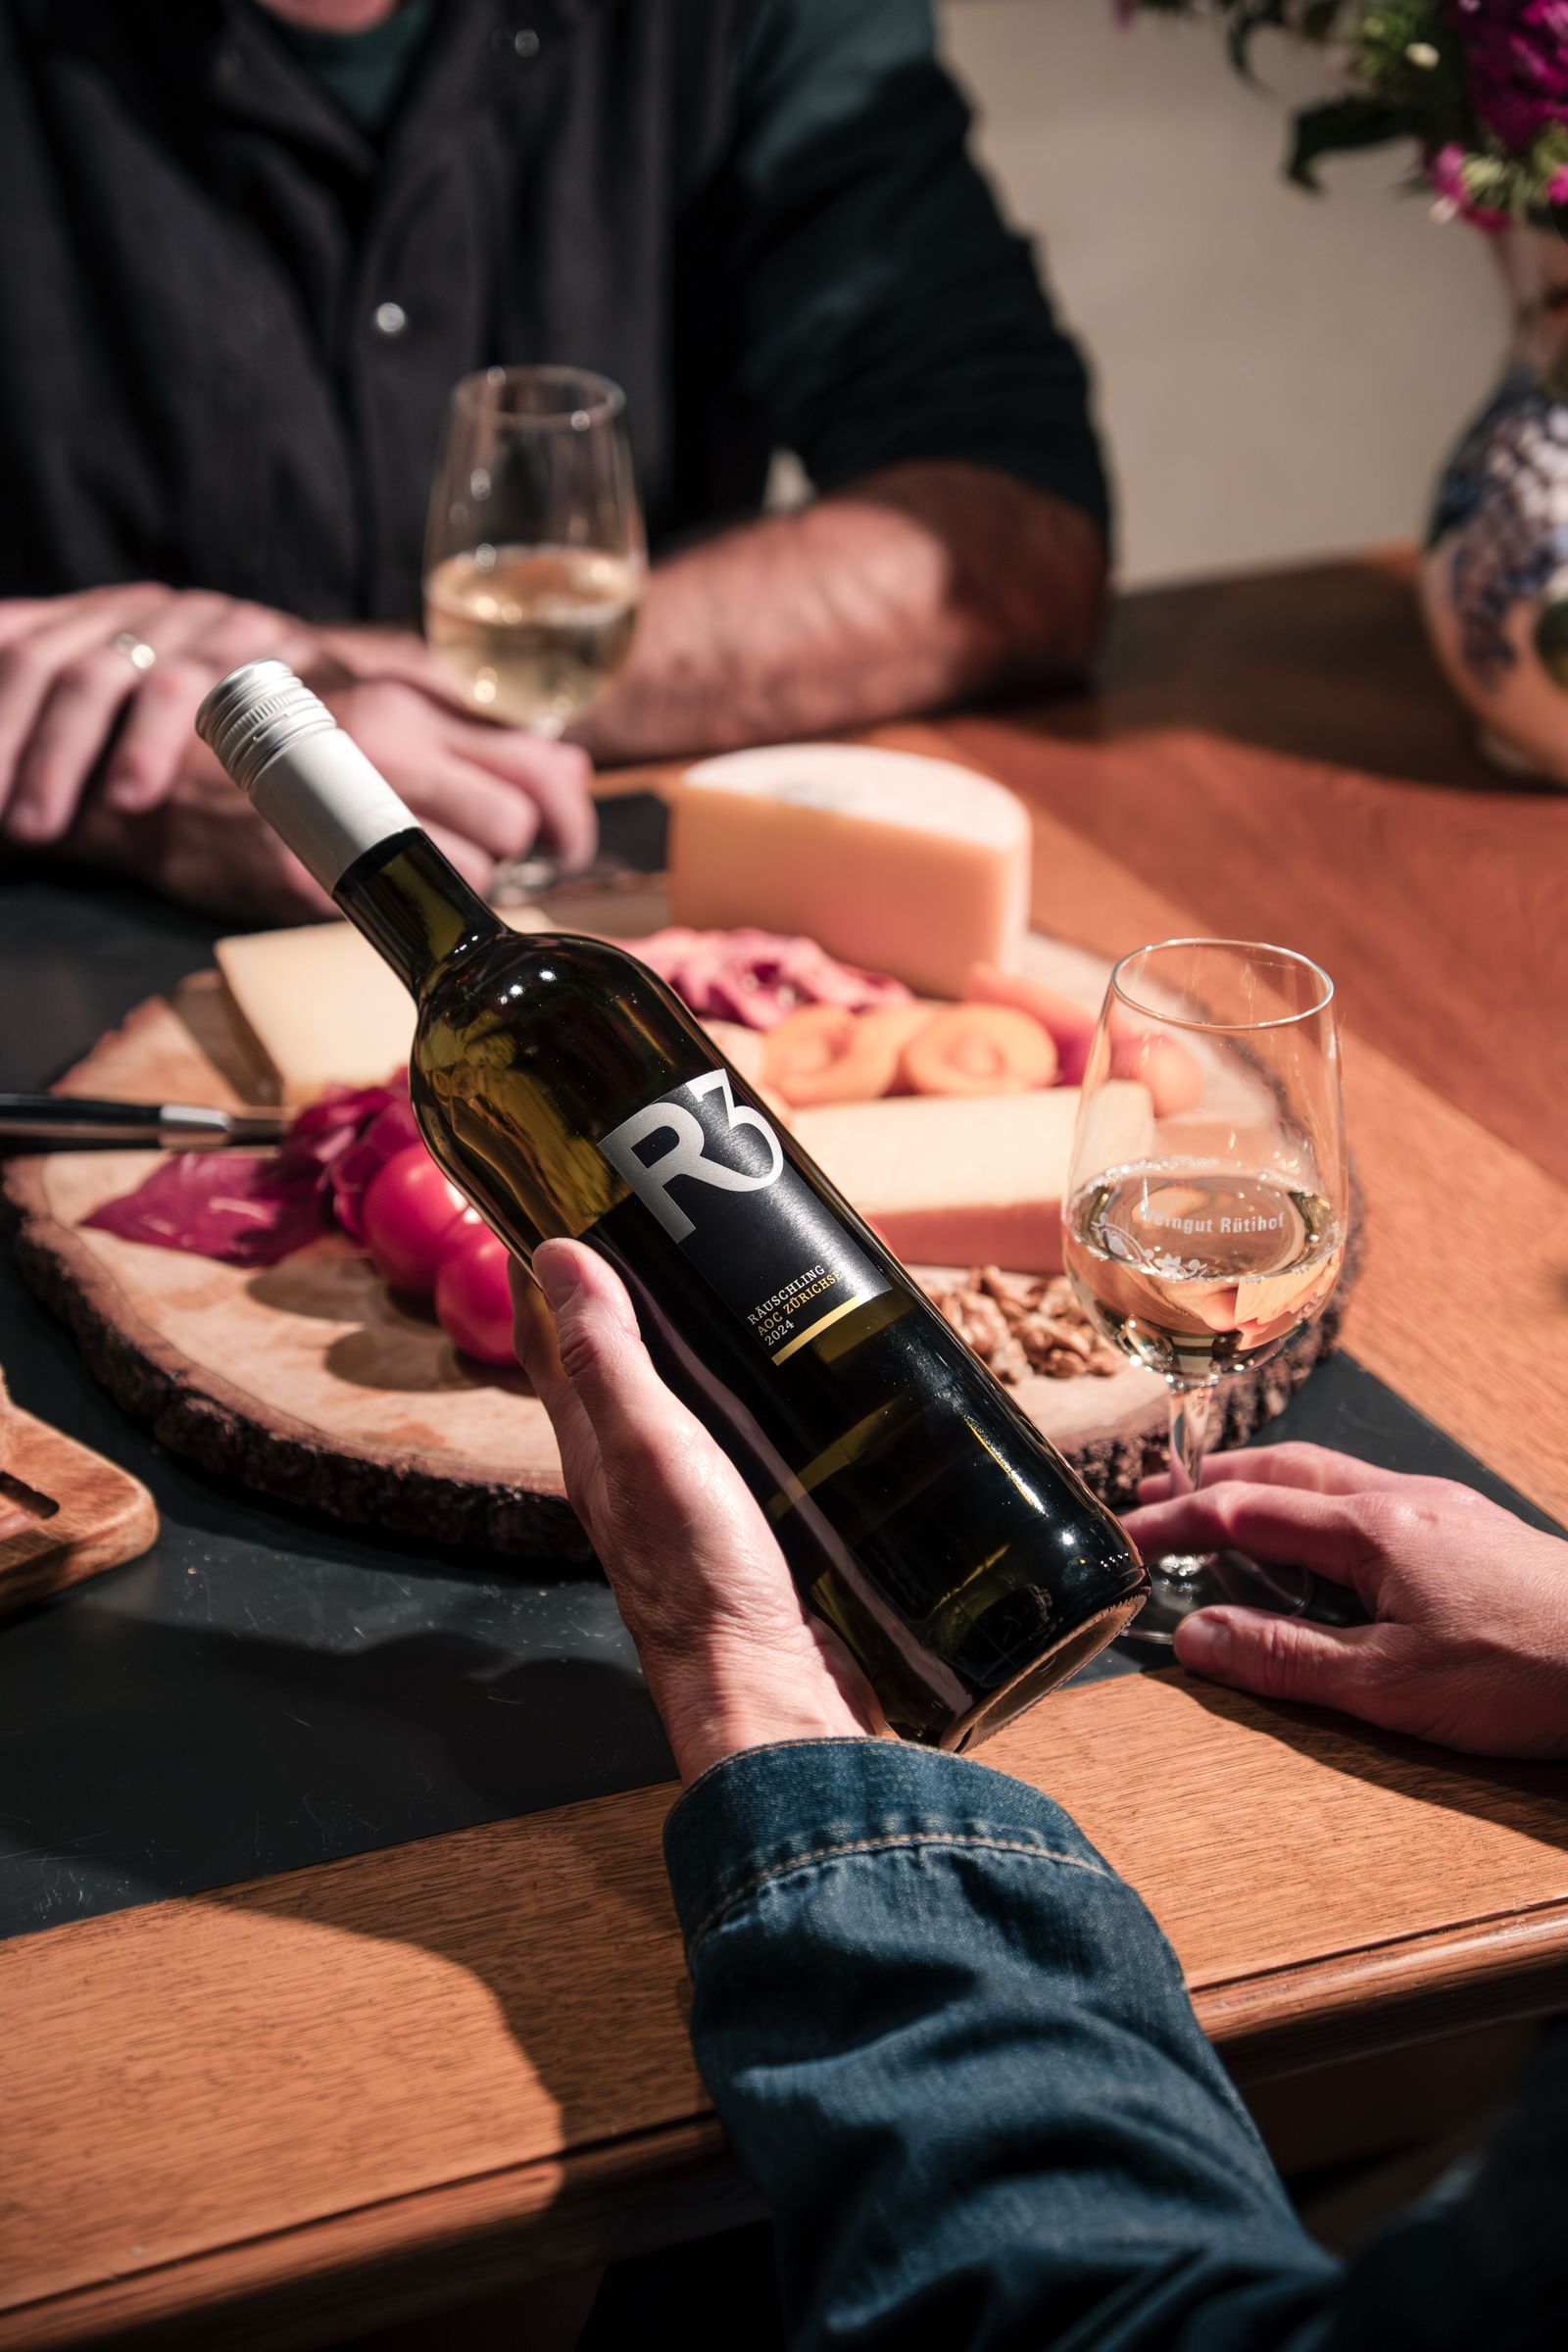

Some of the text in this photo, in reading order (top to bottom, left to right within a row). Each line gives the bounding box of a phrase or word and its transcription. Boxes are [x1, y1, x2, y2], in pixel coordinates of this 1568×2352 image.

[597, 1068, 784, 1244] R3
[1220, 1213, 1285, 1233] Rütihof
[747, 1264, 825, 1325] RÄUSCHLING
[758, 1267, 849, 1336] AOC ZÜRICHSE
[764, 1319, 795, 1347] 2024
